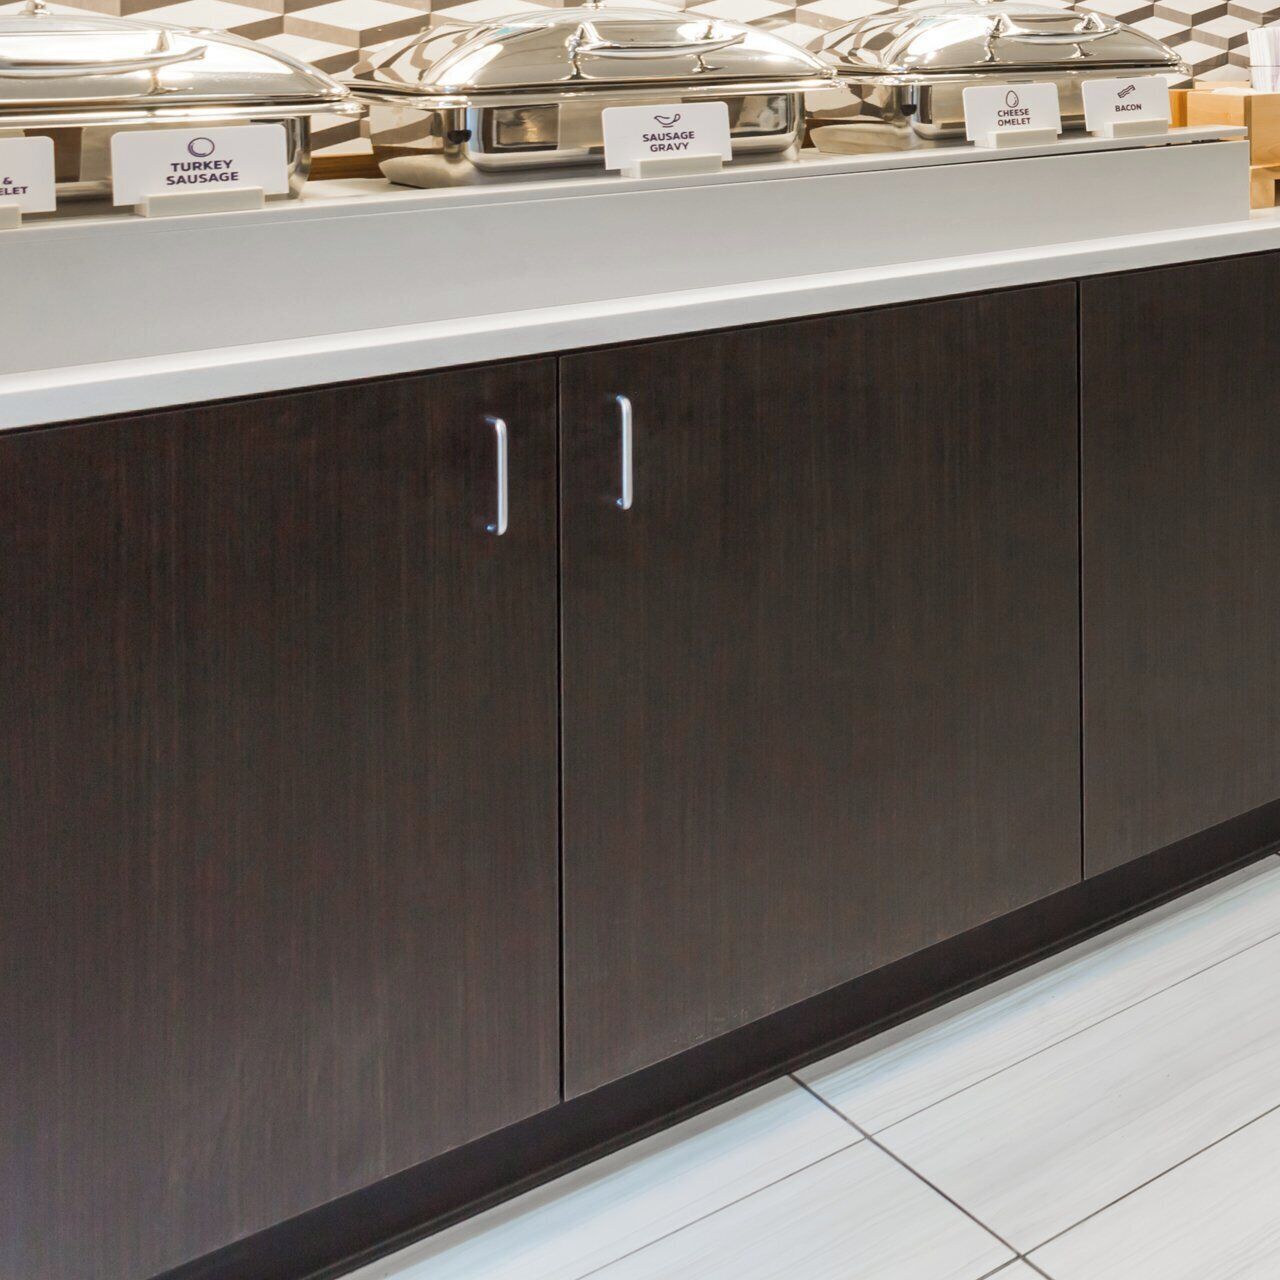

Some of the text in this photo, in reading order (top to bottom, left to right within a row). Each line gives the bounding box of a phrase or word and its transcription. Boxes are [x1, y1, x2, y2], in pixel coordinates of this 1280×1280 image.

[997, 108, 1030, 117] CHEESE
[1115, 104, 1142, 112] BACON
[997, 117, 1031, 127] OMELET
[642, 131, 695, 142] SAUSAGE
[650, 141, 690, 152] GRAVY
[171, 159, 233, 172] TURKEY
[166, 172, 239, 186] SAUSAGE
